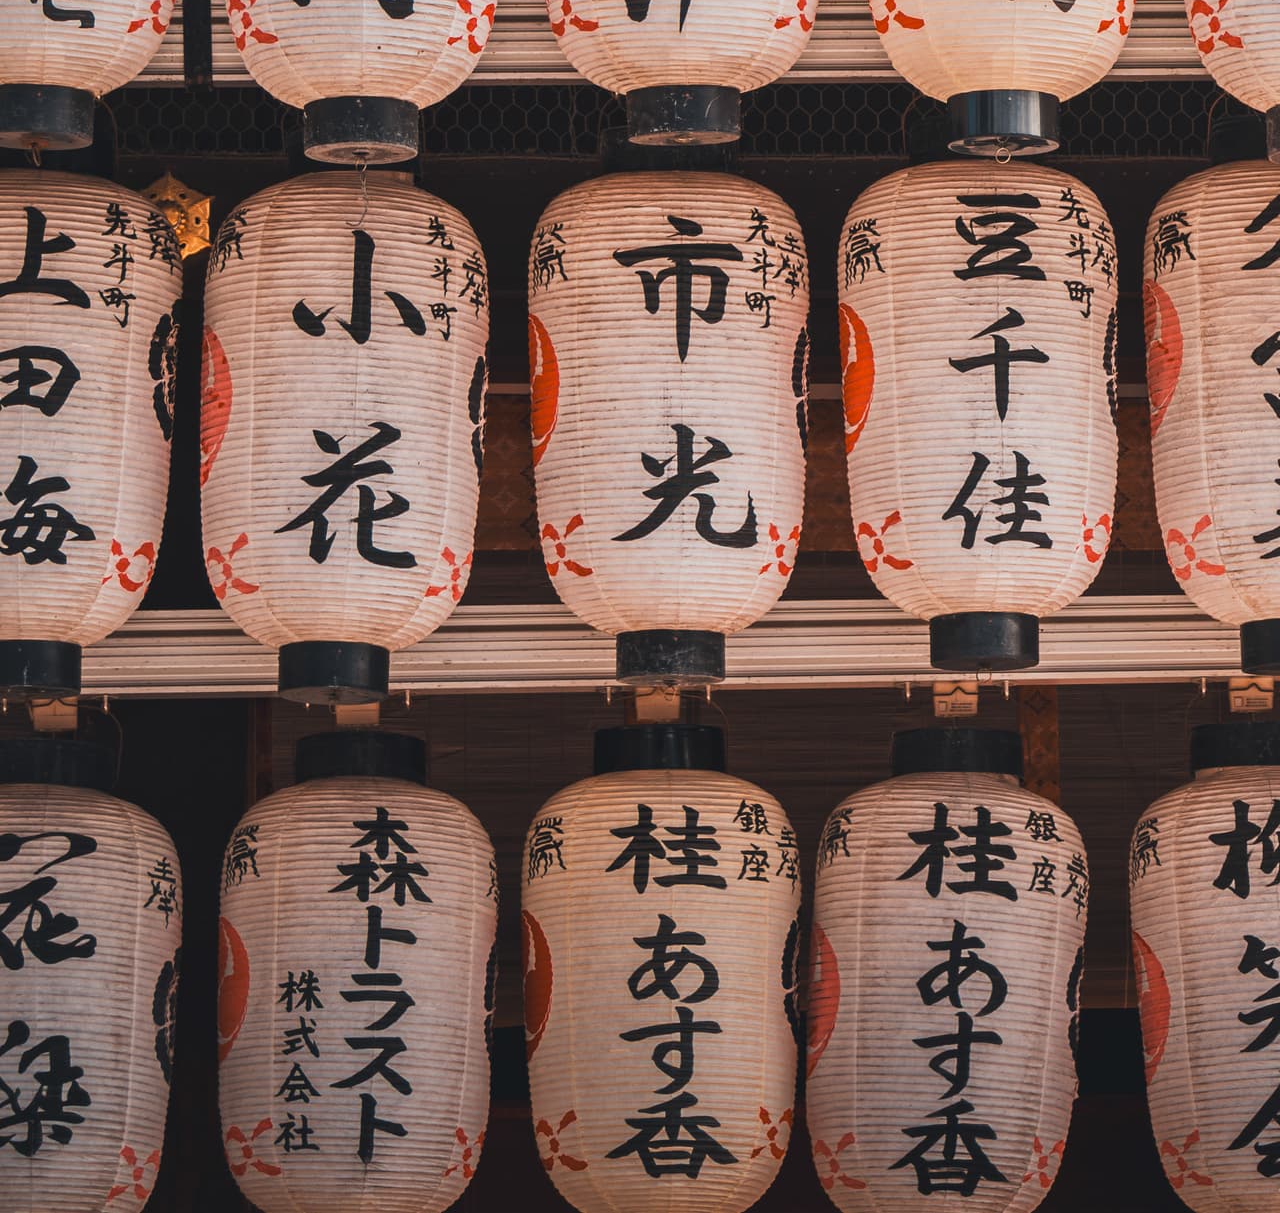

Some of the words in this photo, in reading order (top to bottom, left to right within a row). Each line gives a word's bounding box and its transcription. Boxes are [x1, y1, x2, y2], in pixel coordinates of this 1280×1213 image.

[98, 203, 138, 328] 先斗町
[426, 215, 458, 342] 先斗町
[745, 207, 776, 330] 先斗町
[1057, 188, 1096, 321] 先斗町
[274, 229, 427, 570] 小花
[611, 214, 758, 551] 市光
[942, 190, 1054, 552] 豆千佳
[733, 799, 771, 884] 銀座
[1024, 808, 1065, 897] 銀座
[274, 970, 322, 1153] 株式会社
[329, 806, 433, 1164] 森トラスト
[604, 803, 739, 1181] 桂あす香
[888, 800, 1019, 1198] 桂あす香
